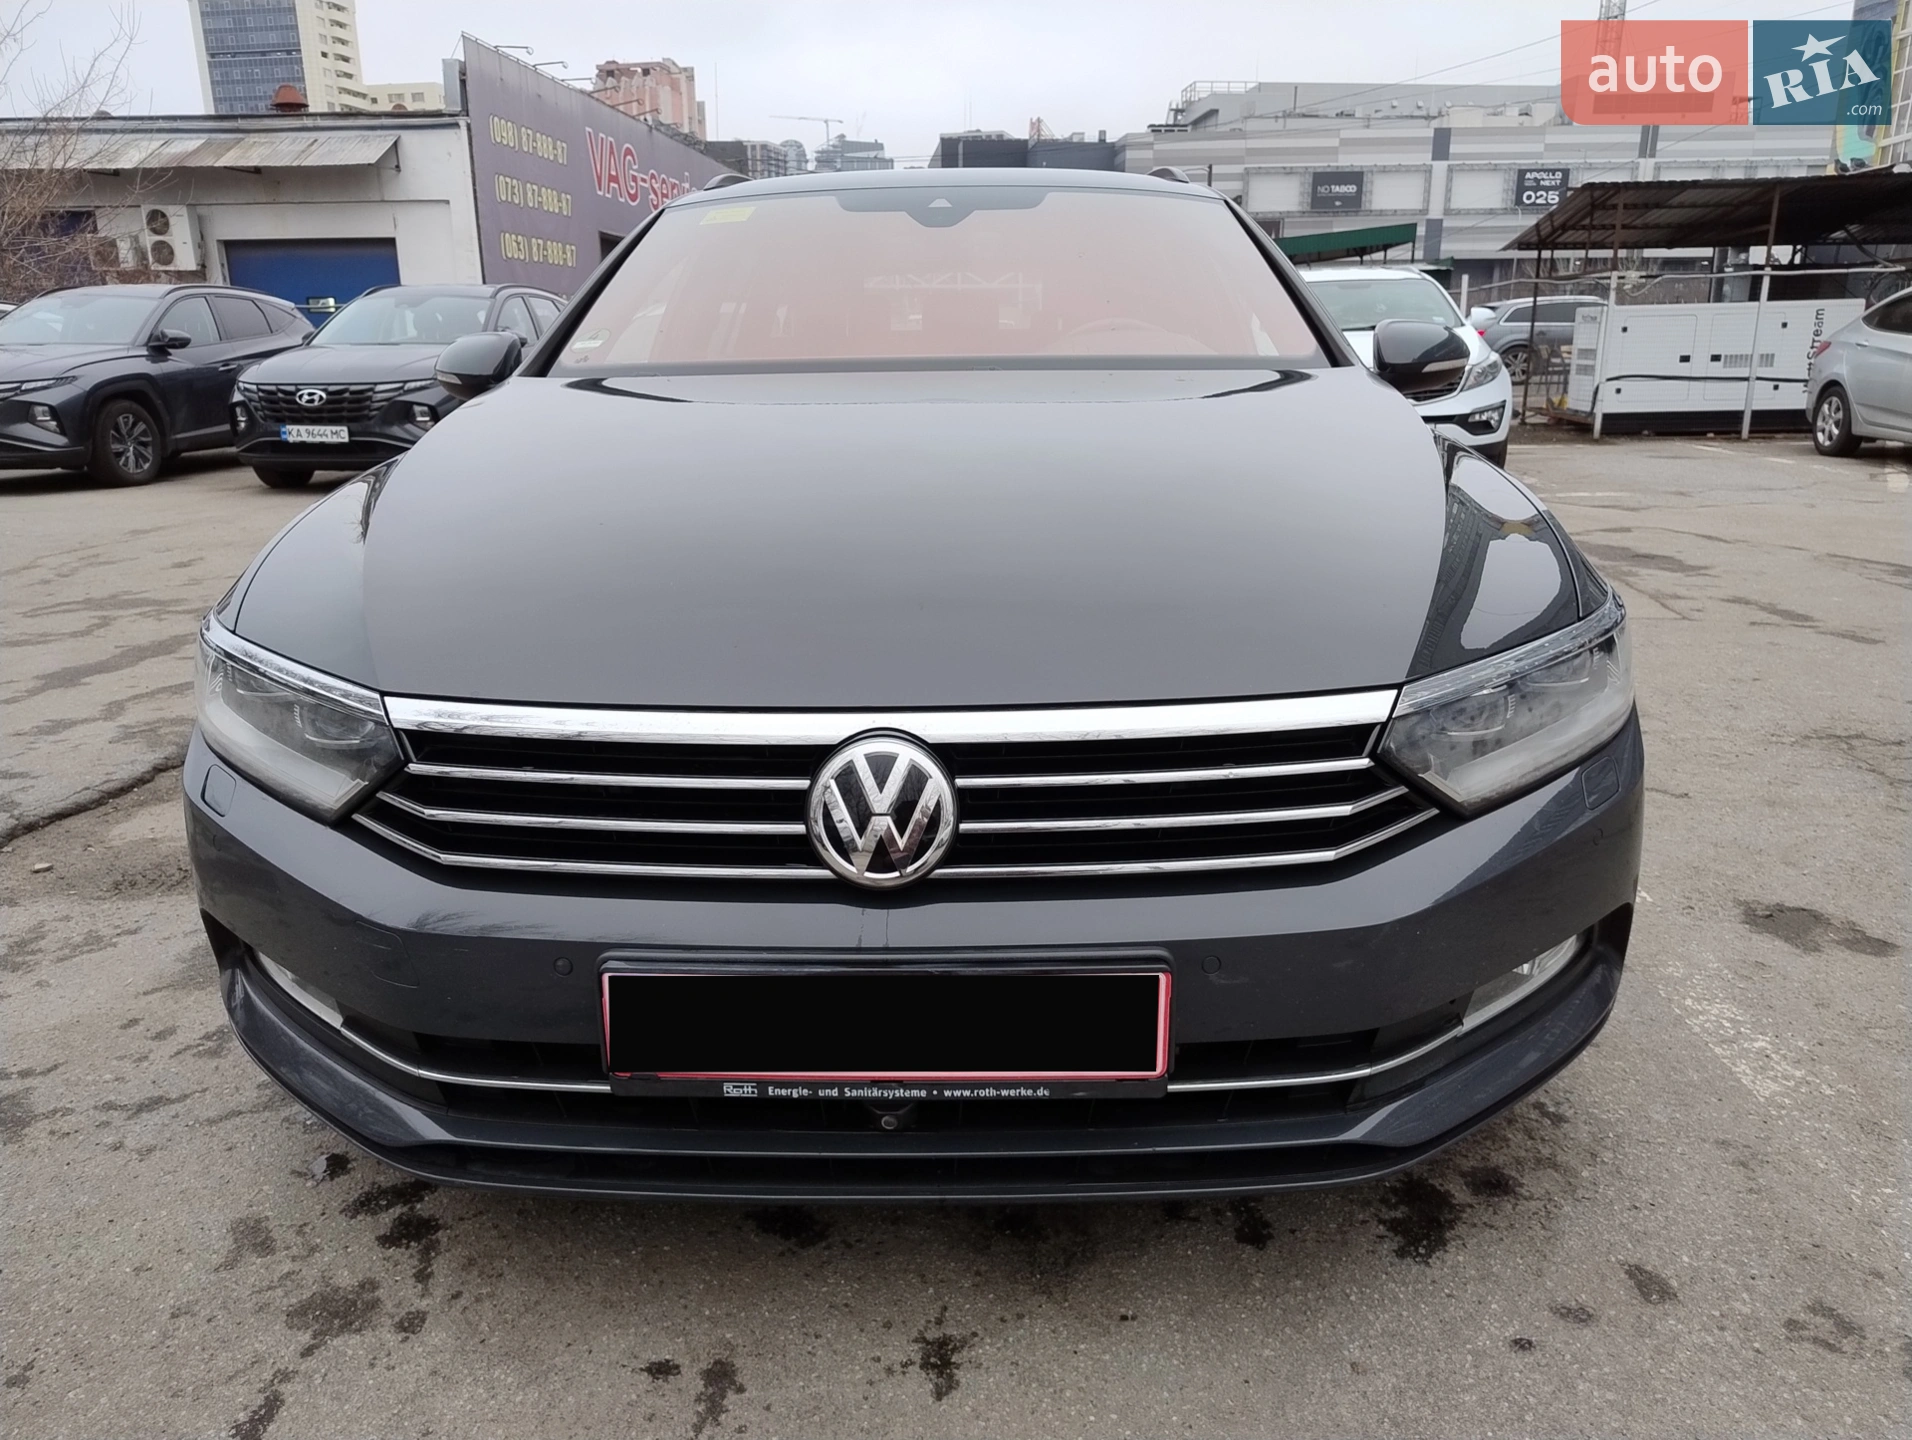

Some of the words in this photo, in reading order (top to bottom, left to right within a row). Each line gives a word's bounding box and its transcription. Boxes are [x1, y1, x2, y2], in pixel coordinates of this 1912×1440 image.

[489, 114, 519, 151] (098)
[520, 125, 568, 166] 87-888-87
[585, 126, 698, 213] VAG-ser
[1524, 171, 1563, 179] APOLLO
[494, 173, 524, 208] (073)
[526, 182, 572, 217] 87-888-87
[1522, 190, 1560, 204] 025
[500, 232, 529, 263] (063)
[530, 237, 577, 268] 87-888-87
[287, 427, 303, 438] KA
[305, 428, 329, 439] 9644
[330, 428, 346, 439] MC
[723, 1083, 757, 1096] Roth
[768, 1086, 813, 1098] Energie-
[818, 1086, 838, 1097] und
[844, 1087, 927, 1099] Sanitärsysteme
[943, 1086, 1050, 1098] www.roth-werke.de
